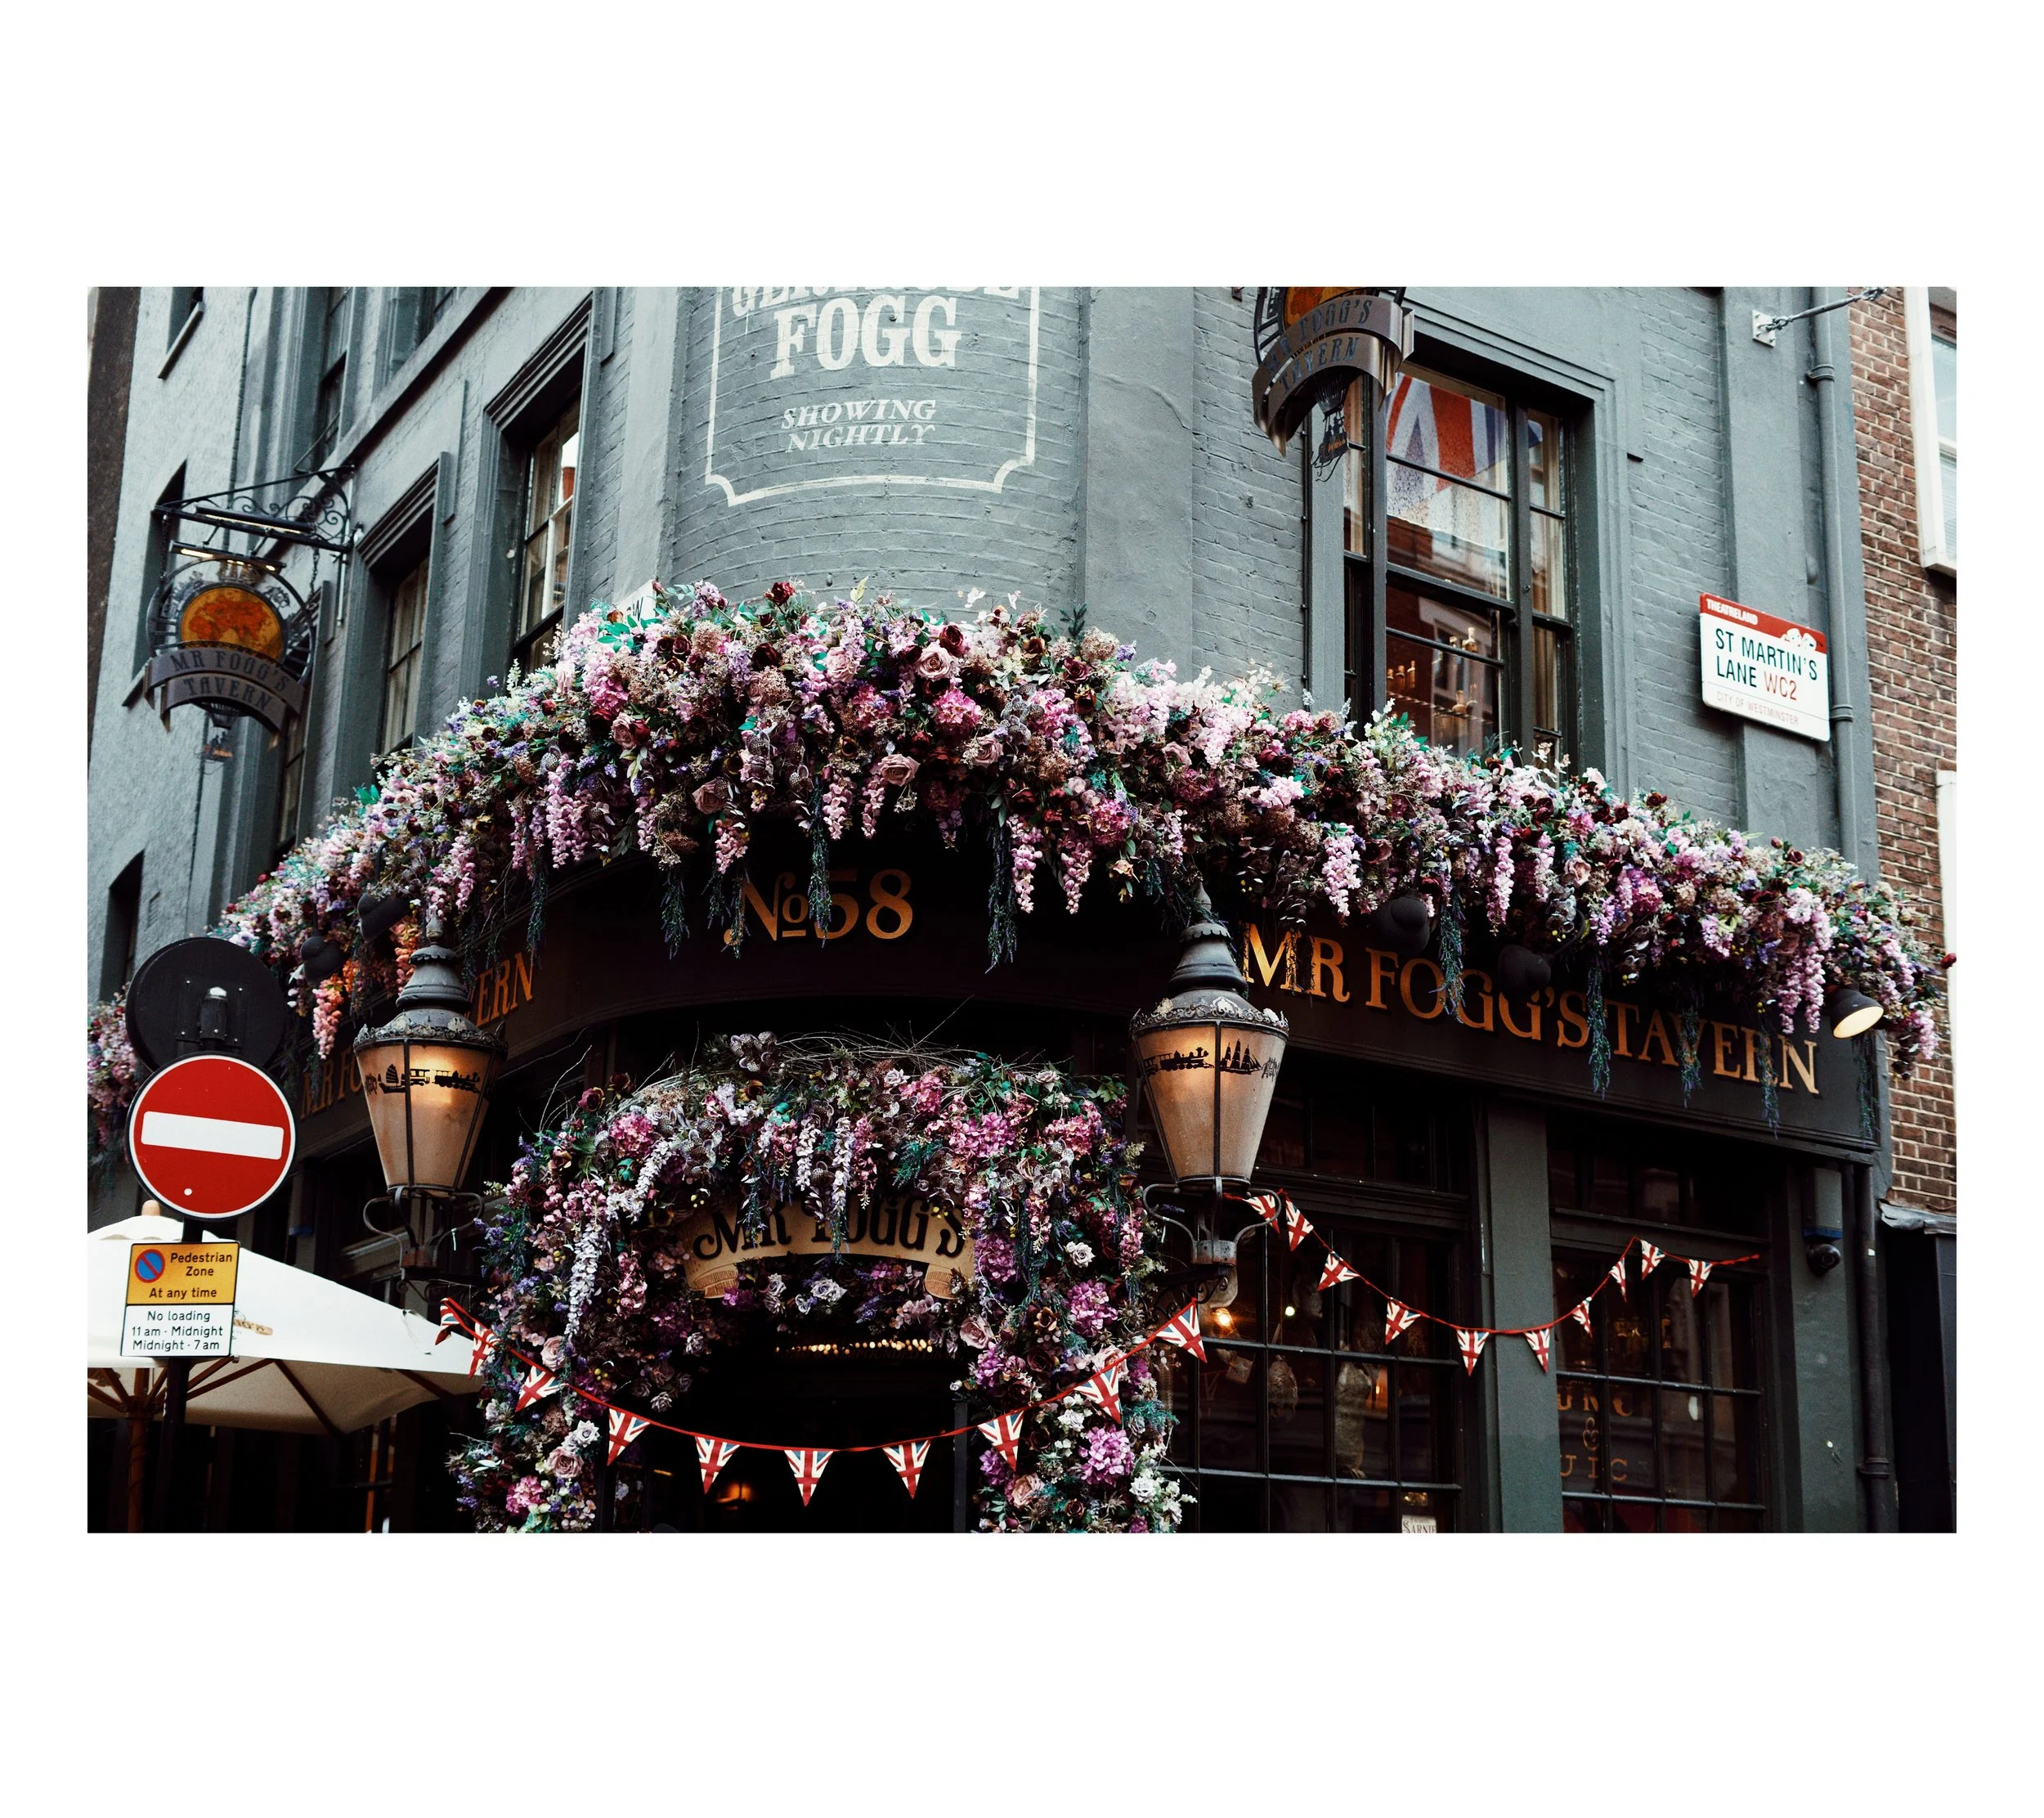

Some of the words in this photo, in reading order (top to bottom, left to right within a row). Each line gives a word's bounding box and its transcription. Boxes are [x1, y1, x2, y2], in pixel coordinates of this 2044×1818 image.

[1299, 299, 1373, 342] FOGG'S
[770, 295, 961, 379] FOGG
[1279, 337, 1360, 393] TAVERN
[780, 399, 936, 430] SHOWING
[785, 424, 935, 454] NIGHTLY
[1706, 599, 1758, 626] THEATRELAND
[1715, 628, 1734, 653] ST
[1741, 636, 1818, 680] MARTIN'S
[169, 649, 204, 673] MR
[216, 649, 290, 693] FOGG'S
[1717, 655, 1757, 688] LANE
[1764, 671, 1797, 701] WC2
[184, 676, 273, 712] TAVERN
[1717, 691, 1732, 705] CITY
[1736, 697, 1744, 708] OF
[1747, 699, 1799, 725] WESTMINSTER
[1238, 919, 1349, 1002] MR
[170, 1253, 233, 1263] Pedestrian
[186, 1266, 214, 1276] Zone
[149, 1288, 163, 1298] At
[167, 1290, 187, 1300] any
[191, 1288, 217, 1297] time
[147, 1311, 164, 1321] No
[168, 1311, 211, 1322] loading
[171, 1326, 223, 1338] Midnight
[132, 1340, 184, 1352] Midnight
